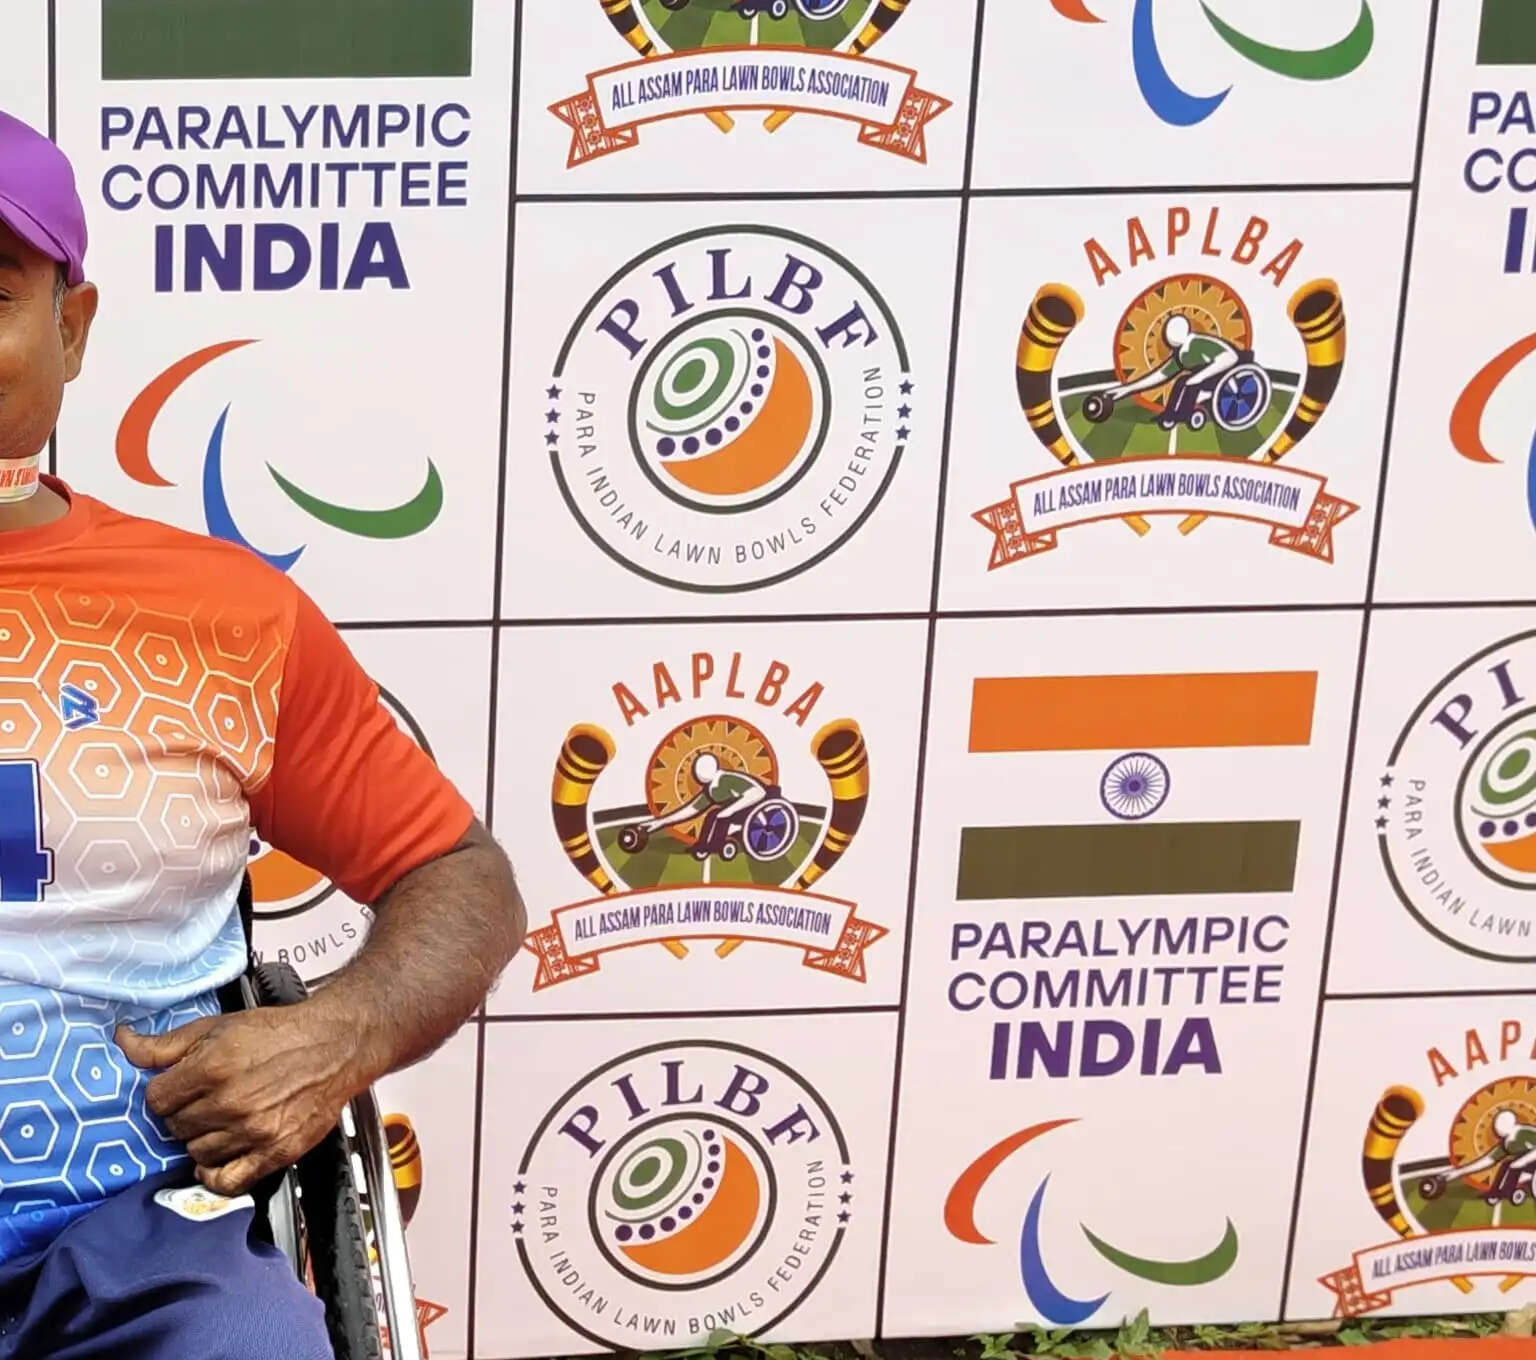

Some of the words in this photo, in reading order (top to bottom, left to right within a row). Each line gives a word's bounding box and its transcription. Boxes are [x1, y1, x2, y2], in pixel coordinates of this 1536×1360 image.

[613, 83, 635, 110] ALL
[639, 71, 682, 104] ASSAM
[687, 67, 718, 94] PARA
[722, 65, 757, 91] LAWN
[762, 66, 804, 90] BOWLS
[807, 69, 890, 107] ASSOCIATION
[102, 103, 470, 150] PARALYMPIC
[102, 161, 467, 210] COMMITTEE
[155, 222, 409, 292] INDIA
[1084, 206, 1304, 288] AAPLBA
[595, 248, 878, 360] PILBF
[577, 392, 597, 457] PARA
[587, 468, 648, 540] INDIAN
[655, 534, 721, 564] LAWN
[736, 517, 817, 563] BOWLS
[820, 367, 884, 517] FEDERATION
[1034, 490, 1056, 516] ALL
[1059, 479, 1101, 510] ASSAM
[1106, 476, 1136, 500] PARA
[1140, 473, 1175, 498] LAWN
[1178, 474, 1220, 496] BOWLS
[1221, 476, 1301, 511] ASSOCIATION
[612, 651, 825, 728] AAPLBA
[1406, 779, 1426, 840] PARA
[1411, 849, 1465, 916] INDIAN
[278, 922, 357, 964] BOWLS
[576, 917, 596, 941] ALL
[600, 906, 640, 935] ASSAM
[644, 903, 673, 926] PARA
[677, 900, 710, 923] LAWN
[714, 901, 753, 921] BOWLS
[756, 903, 832, 935] ASSOCIATION
[952, 916, 1289, 960] PARALYMPIC
[1470, 910, 1531, 936] LAWN
[949, 965, 1283, 1011] COMMITTEE
[990, 1018, 1221, 1079] INDIA
[557, 1060, 821, 1158] PILBF
[541, 1187, 560, 1244] PARA
[768, 1160, 826, 1291] FEDERATION
[550, 1252, 607, 1315] INDIAN
[690, 1291, 765, 1333] BOWLS
[613, 1309, 675, 1334] LAWN
